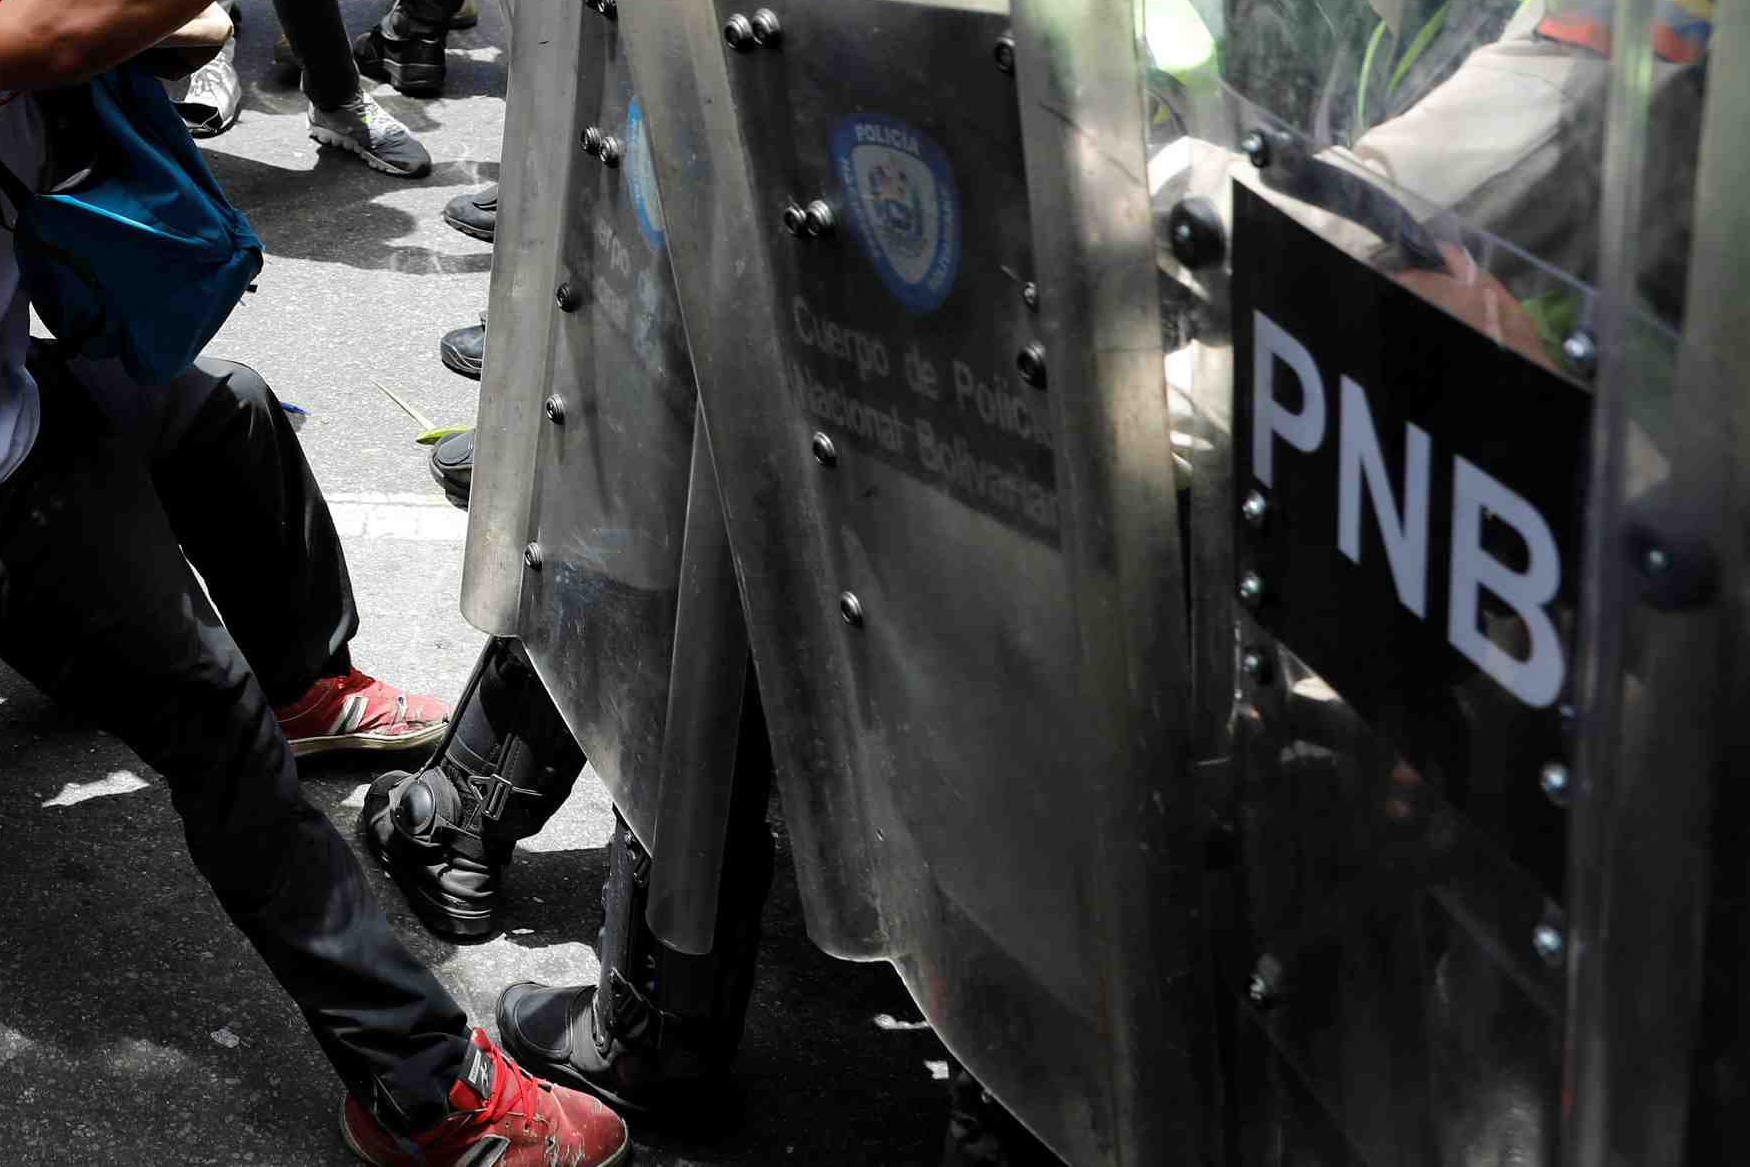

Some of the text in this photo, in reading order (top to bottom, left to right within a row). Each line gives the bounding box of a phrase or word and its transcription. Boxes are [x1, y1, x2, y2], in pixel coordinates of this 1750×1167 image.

[792, 295, 890, 382] Cuerpo
[904, 341, 939, 401] de
[1252, 308, 1566, 709] PNB
